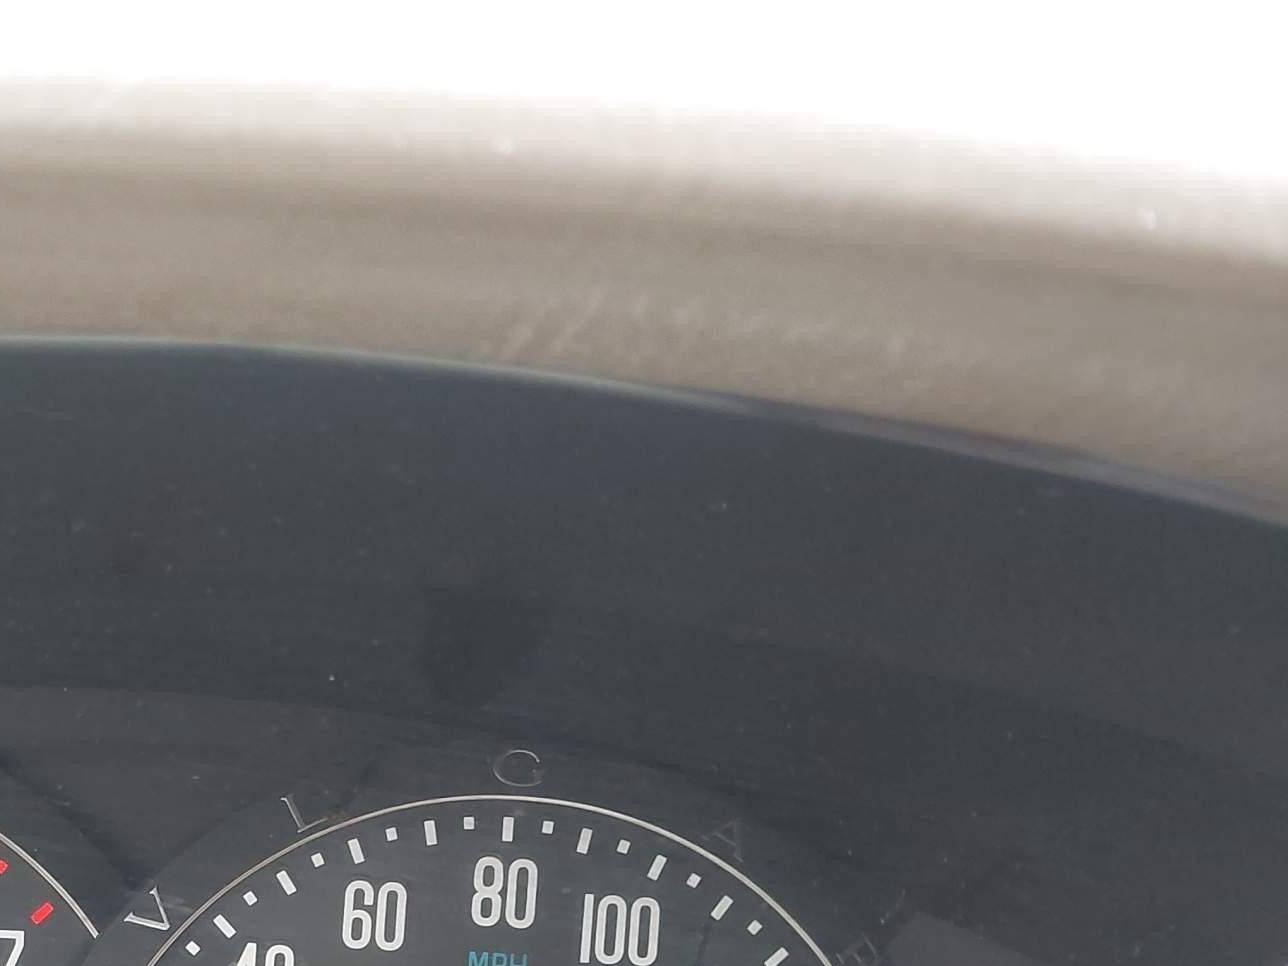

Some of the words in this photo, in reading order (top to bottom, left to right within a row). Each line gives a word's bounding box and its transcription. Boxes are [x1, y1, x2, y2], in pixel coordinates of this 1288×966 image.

[342, 880, 407, 951] 60
[471, 856, 538, 929] 80
[579, 893, 660, 966] 100
